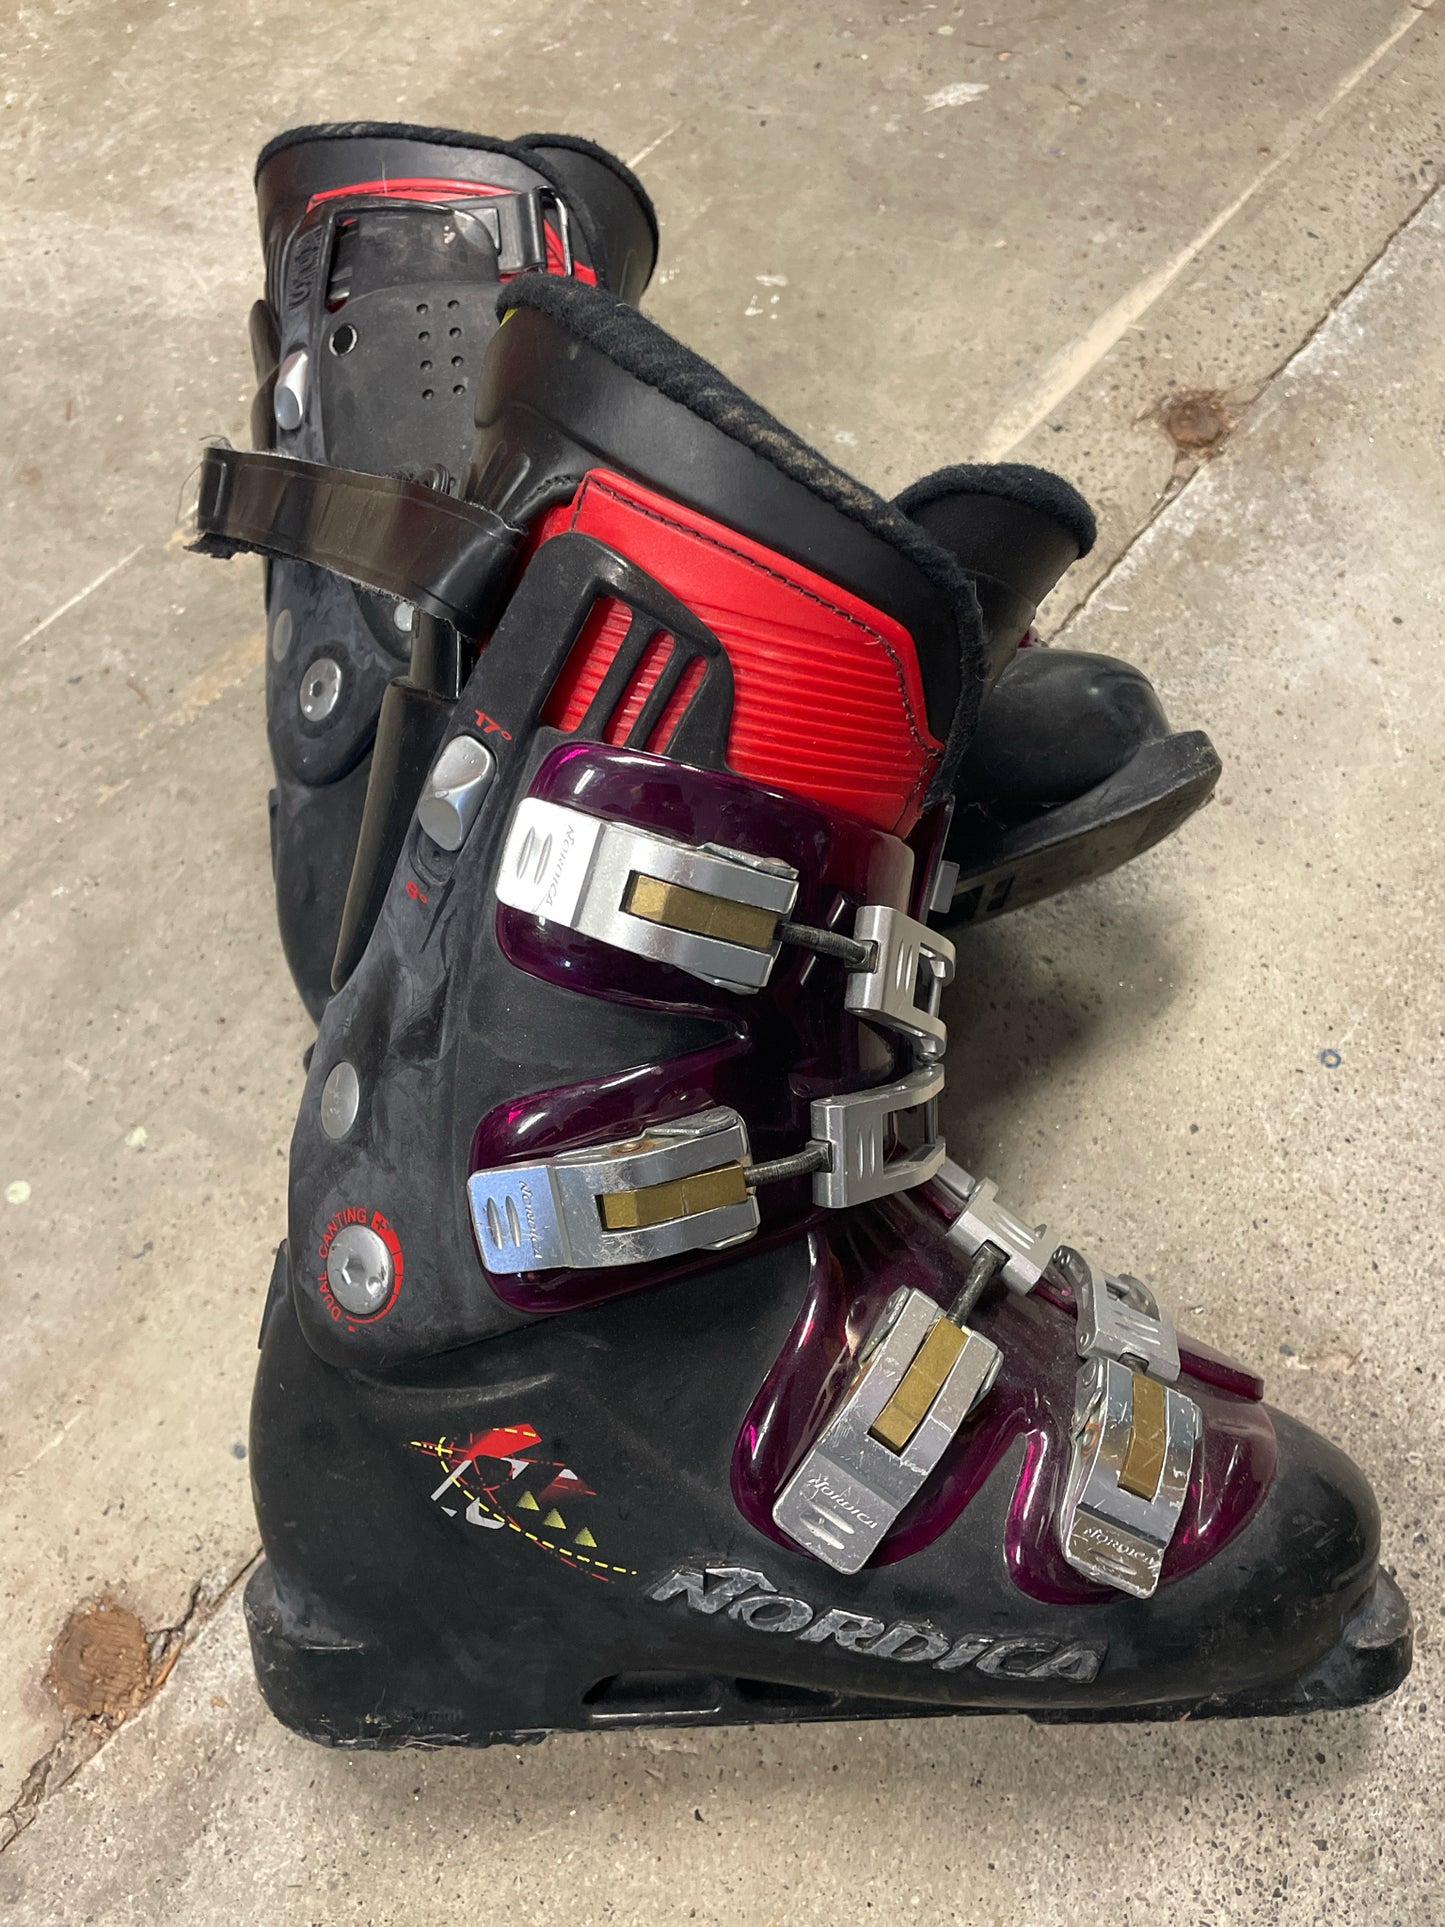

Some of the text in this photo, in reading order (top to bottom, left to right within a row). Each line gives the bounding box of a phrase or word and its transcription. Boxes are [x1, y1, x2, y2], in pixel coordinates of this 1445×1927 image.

[317, 1206, 368, 1322] DUAL CANTING
[807, 1476, 878, 1529] NORDICA
[649, 1565, 1107, 1684] NORDICA
